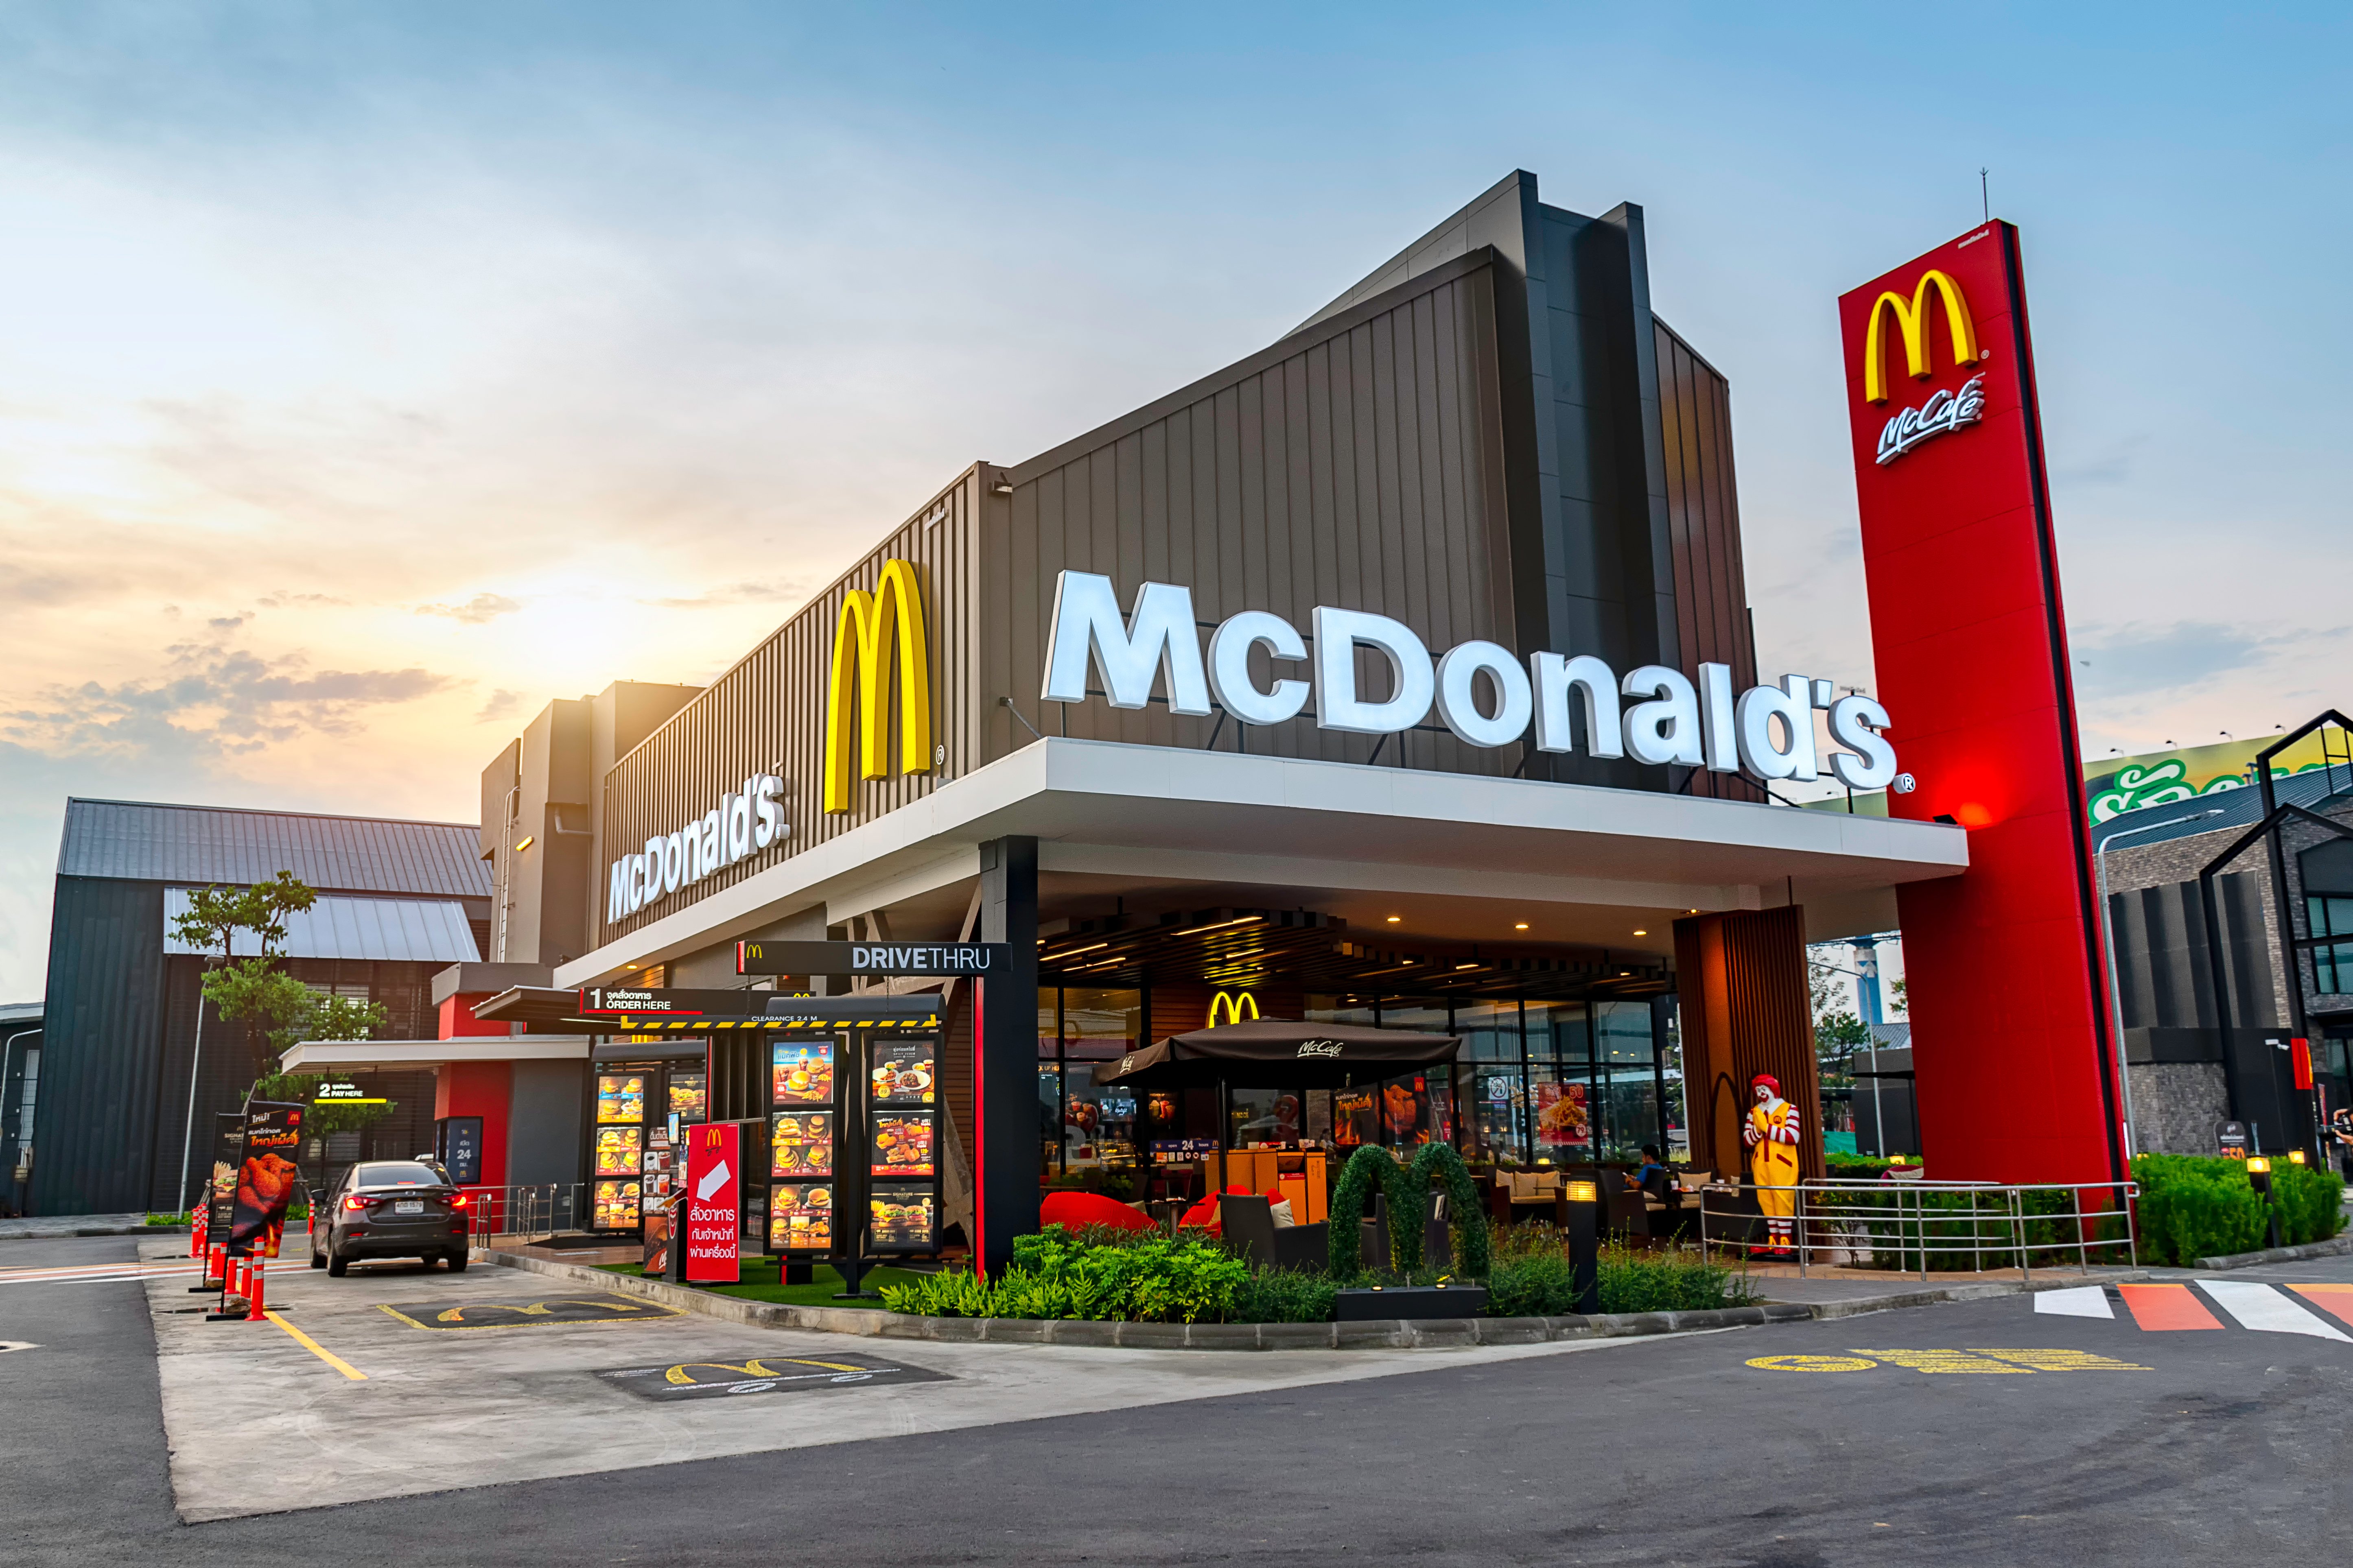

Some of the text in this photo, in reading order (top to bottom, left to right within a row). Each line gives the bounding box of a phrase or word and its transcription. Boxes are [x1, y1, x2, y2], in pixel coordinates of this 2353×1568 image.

[1876, 378, 1984, 464] McCafé
[590, 988, 652, 1009] 1 จุดสั่งอาหาร
[606, 1001, 671, 1010] ORDER HERE
[1297, 1040, 1344, 1058] McCafé
[319, 1083, 331, 1097] 2
[1182, 1140, 1194, 1150] 24
[457, 1149, 471, 1159] 24
[690, 1202, 735, 1221] สั่งอาหาร
[692, 1225, 734, 1240] กับเจ้าหน้าที่
[690, 1243, 736, 1259] ผ่านเครื่องนี้
